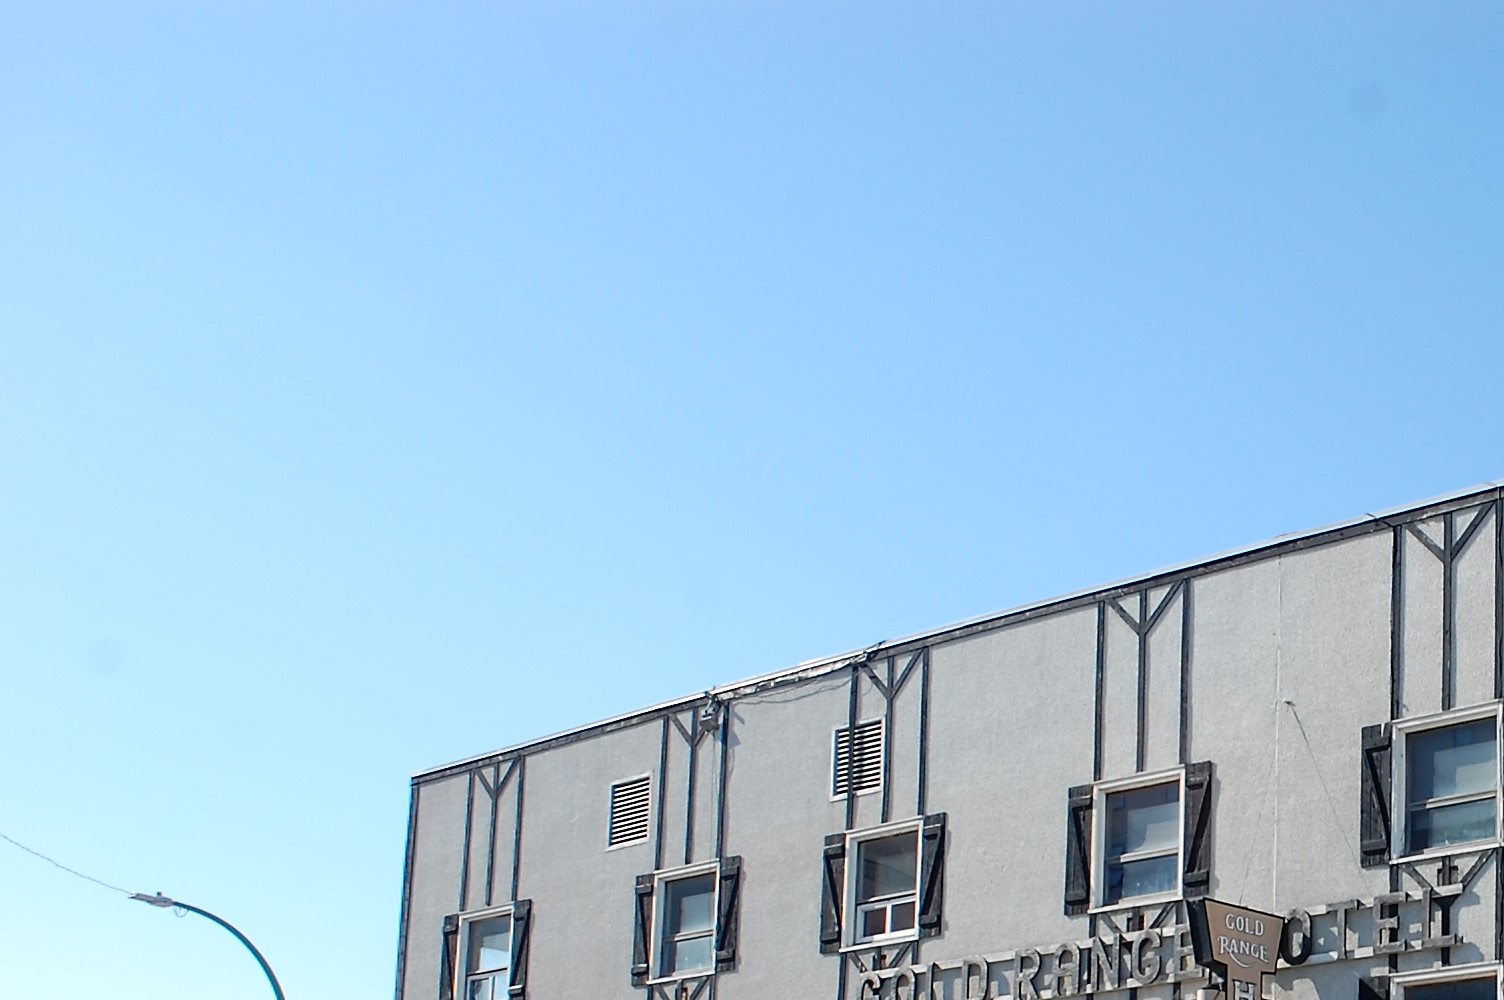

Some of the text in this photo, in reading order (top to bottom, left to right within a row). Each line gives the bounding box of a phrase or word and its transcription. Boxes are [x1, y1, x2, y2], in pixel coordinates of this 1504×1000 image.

[1225, 912, 1264, 936] GOLD
[1280, 886, 1464, 966] OTEL
[1217, 935, 1269, 967] RANGE
